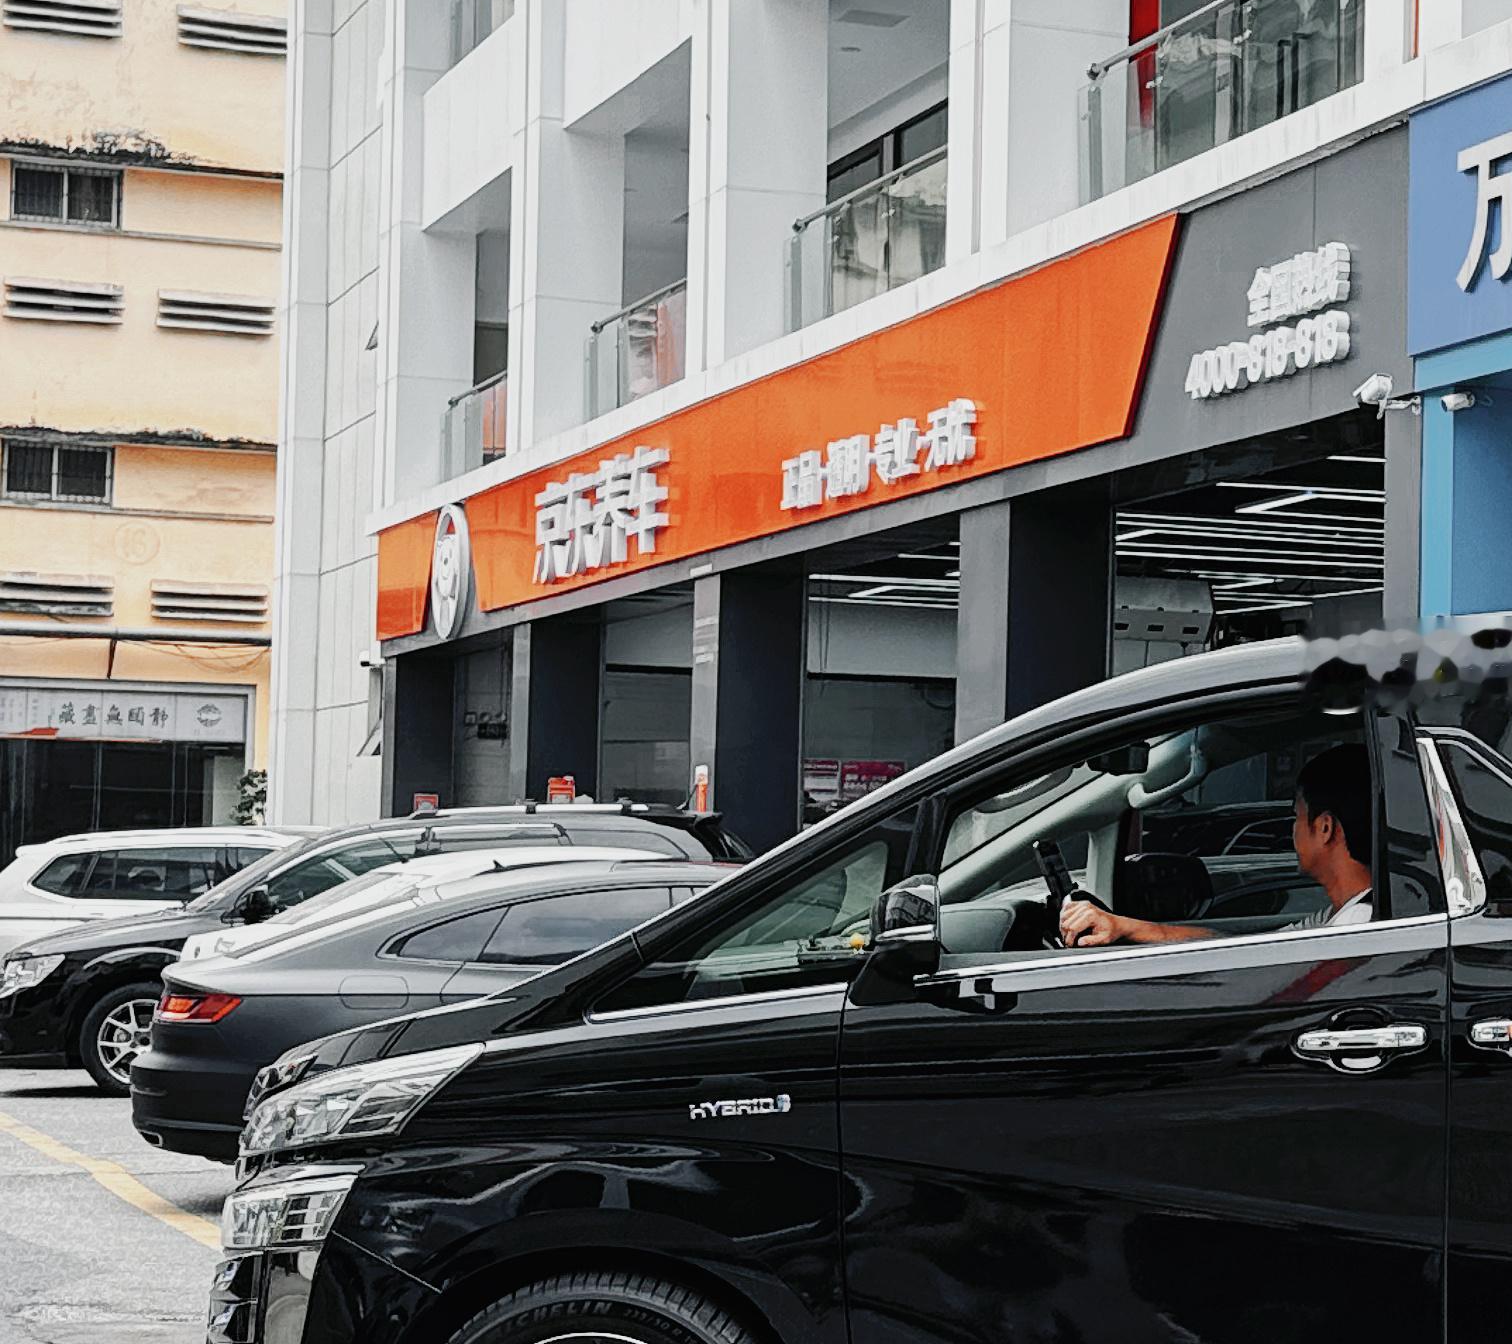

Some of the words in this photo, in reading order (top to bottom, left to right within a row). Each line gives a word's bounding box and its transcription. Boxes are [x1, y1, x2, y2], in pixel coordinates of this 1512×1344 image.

[532, 445, 671, 585] 京东养车
[688, 1097, 775, 1120] HYBRID
